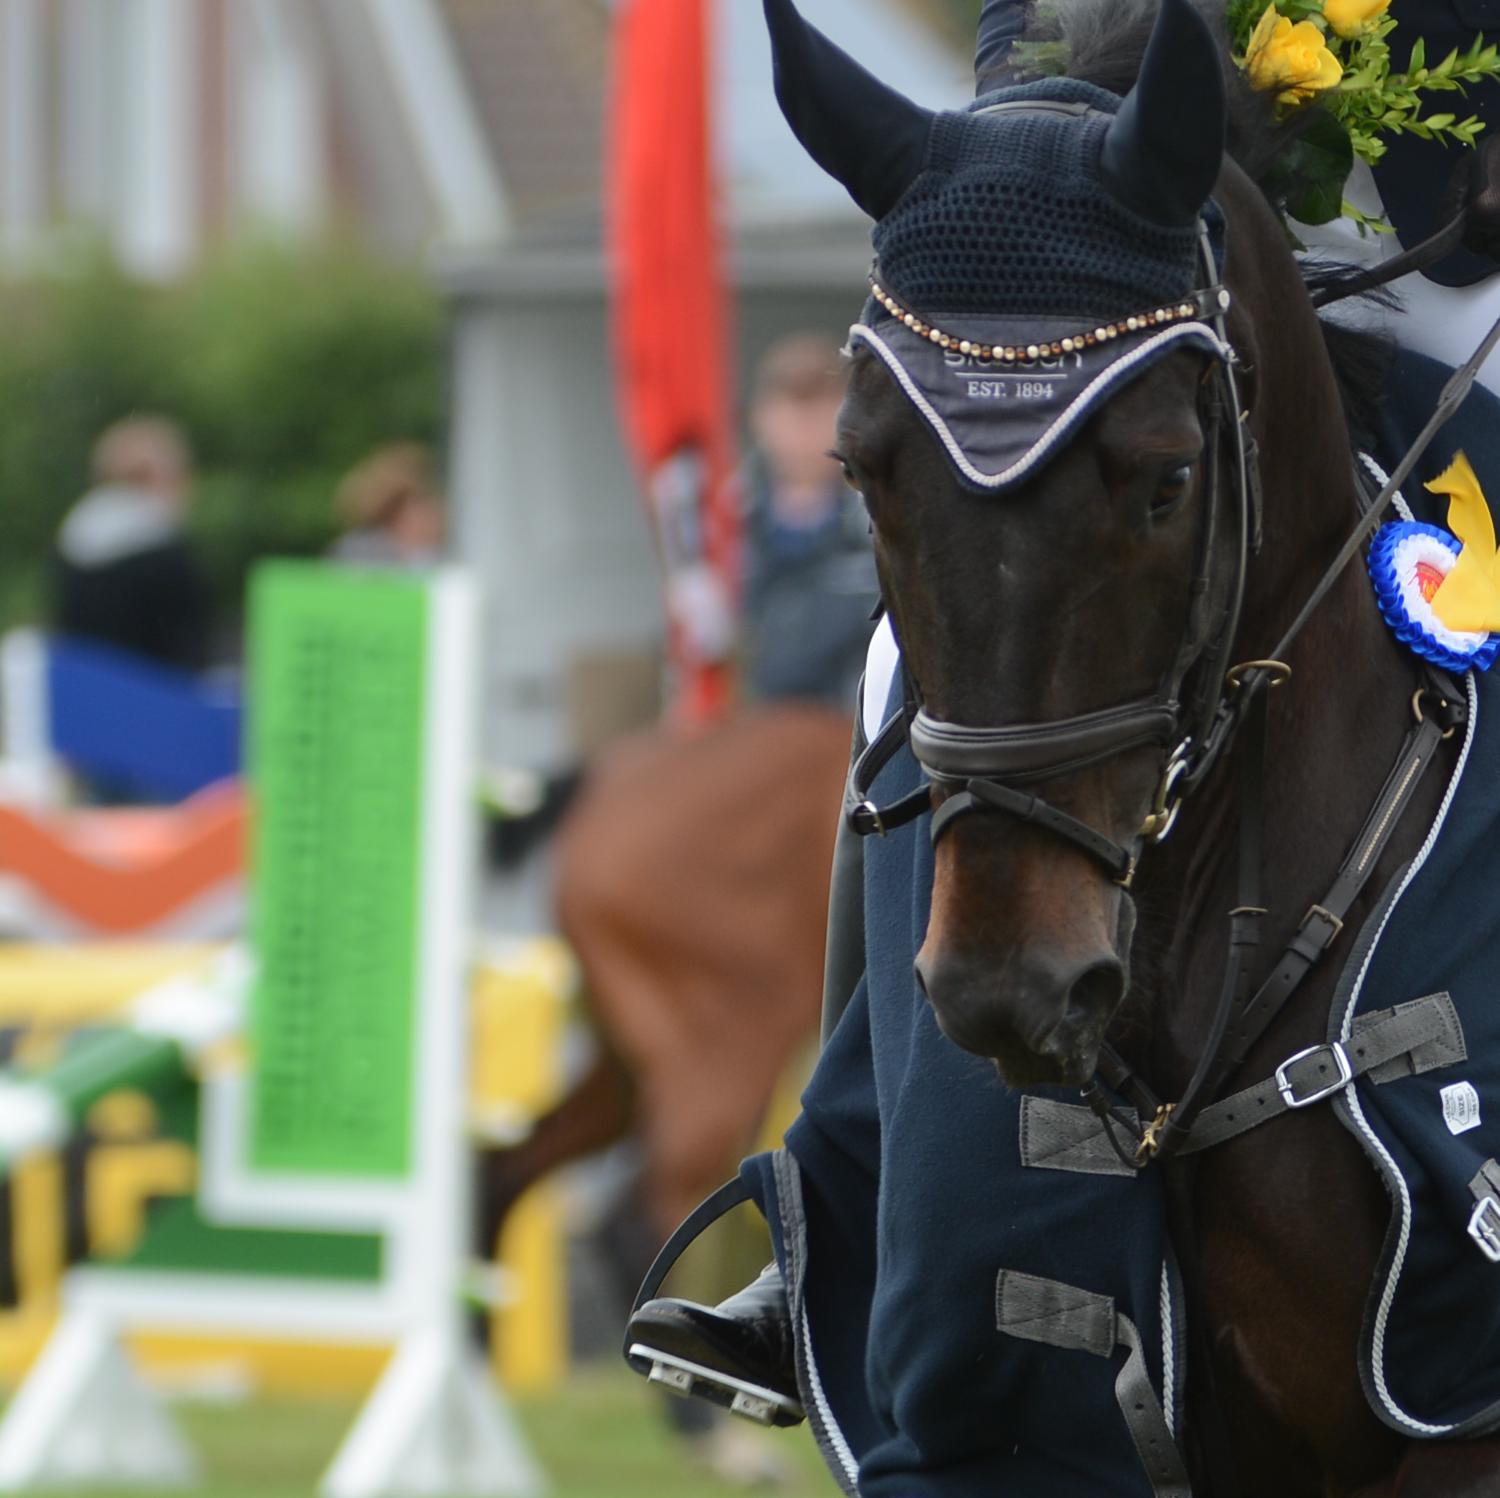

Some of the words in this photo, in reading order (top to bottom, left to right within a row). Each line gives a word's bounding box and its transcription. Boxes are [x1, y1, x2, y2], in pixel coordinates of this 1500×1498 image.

[966, 381, 1006, 397] EST.
[1015, 382, 1053, 398] 1894
[1457, 1094, 1466, 1117] SIZE
